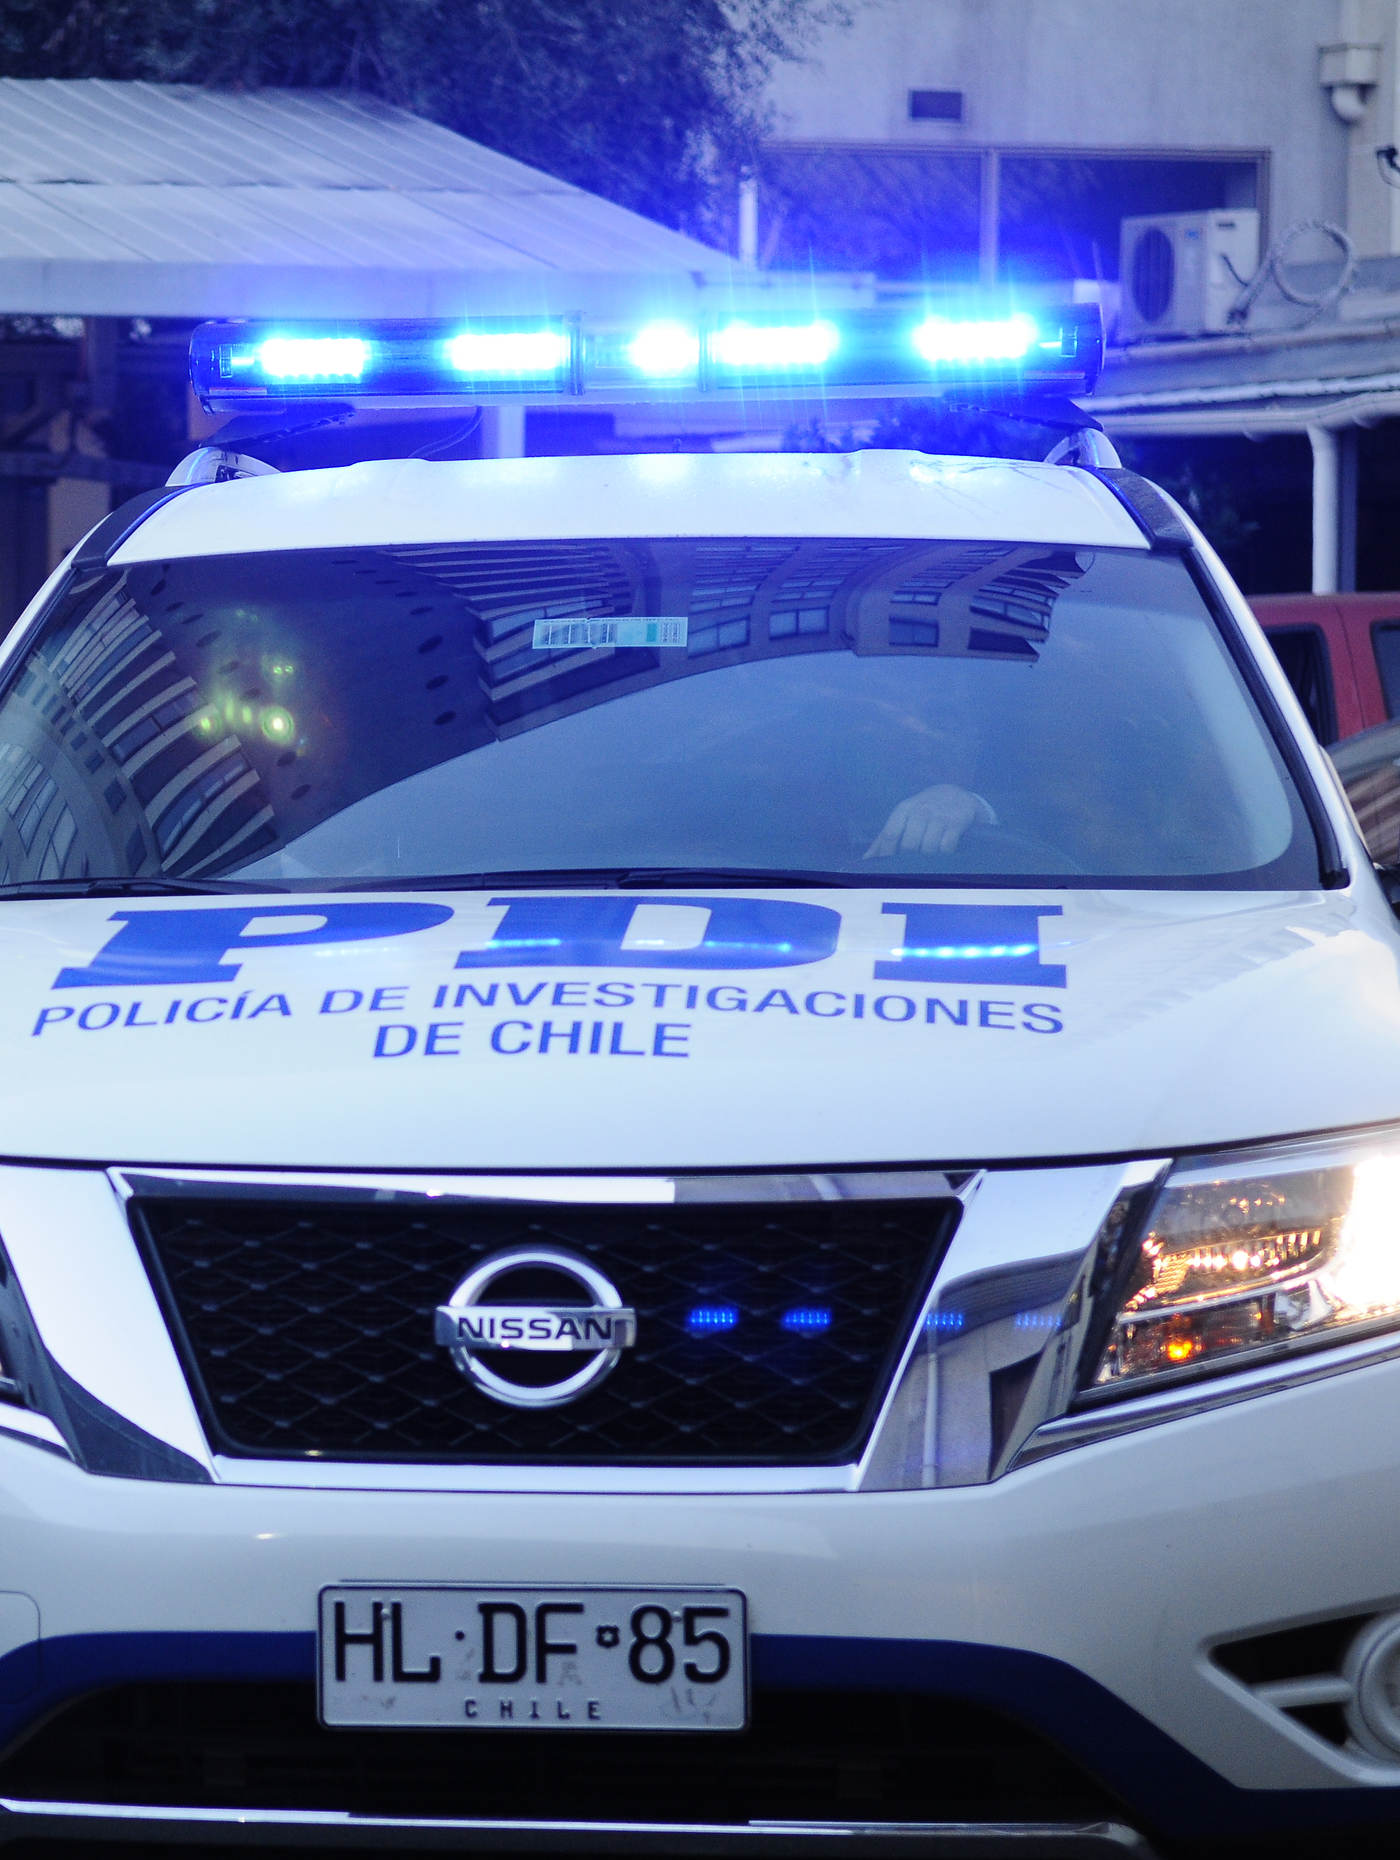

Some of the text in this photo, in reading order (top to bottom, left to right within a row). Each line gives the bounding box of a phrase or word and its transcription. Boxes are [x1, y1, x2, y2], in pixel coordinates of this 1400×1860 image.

[51, 896, 1068, 989] PDI
[31, 981, 1064, 1036] POLICÍA DE INVESTIGACIONES
[372, 1020, 692, 1058] DE CHILE
[456, 1316, 613, 1341] NISSAN
[464, 1699, 601, 1720] CHILE
